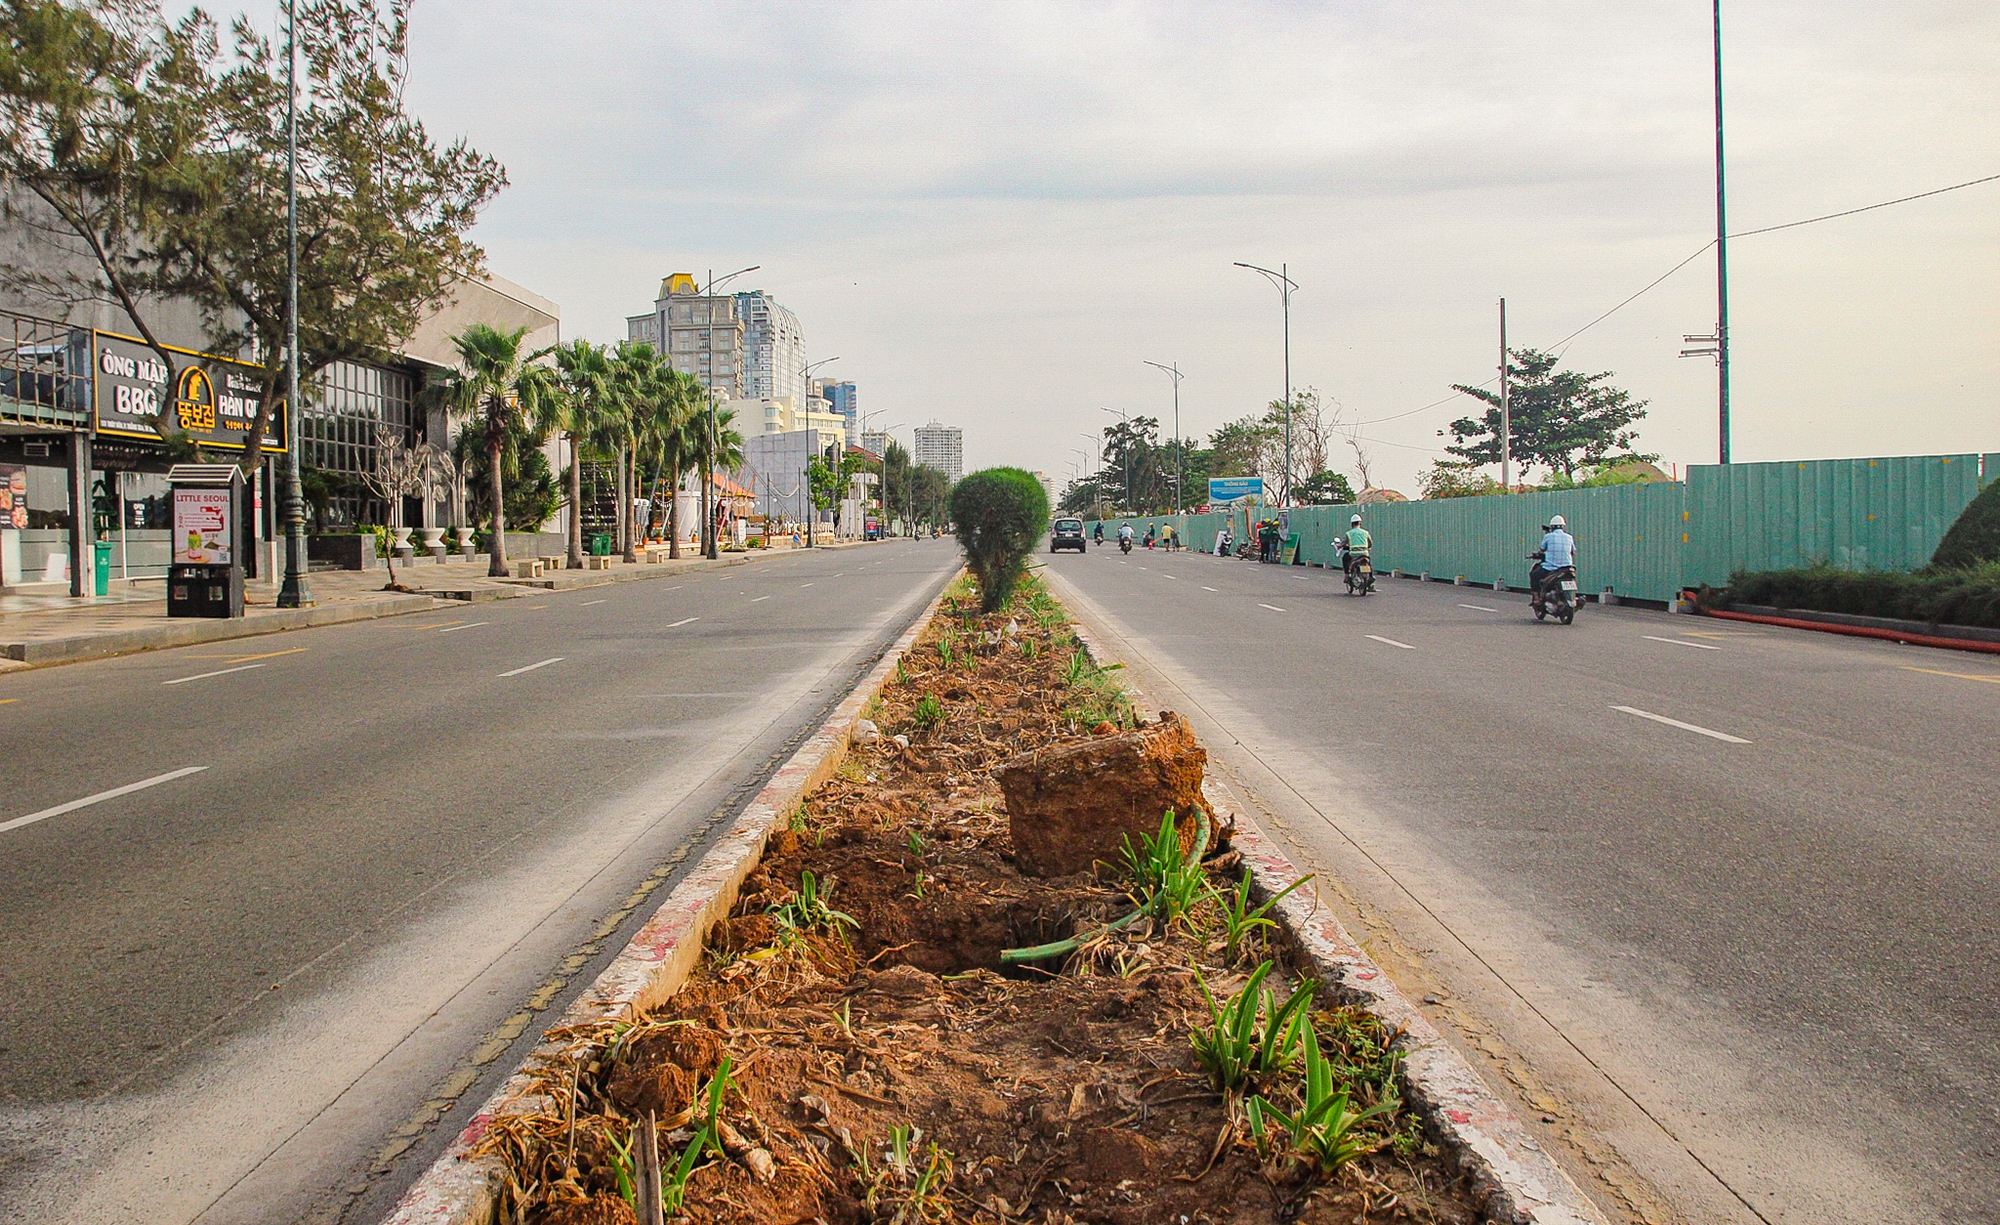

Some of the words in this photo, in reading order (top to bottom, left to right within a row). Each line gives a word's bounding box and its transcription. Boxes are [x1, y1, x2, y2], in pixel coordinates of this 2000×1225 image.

[102, 347, 135, 378] ÔNG
[116, 384, 159, 417] BBQ
[218, 390, 243, 417] HÀN
[178, 401, 215, 430] 뚱보집
[176, 494, 201, 502] LITTLE
[203, 494, 229, 502] SEOUL
